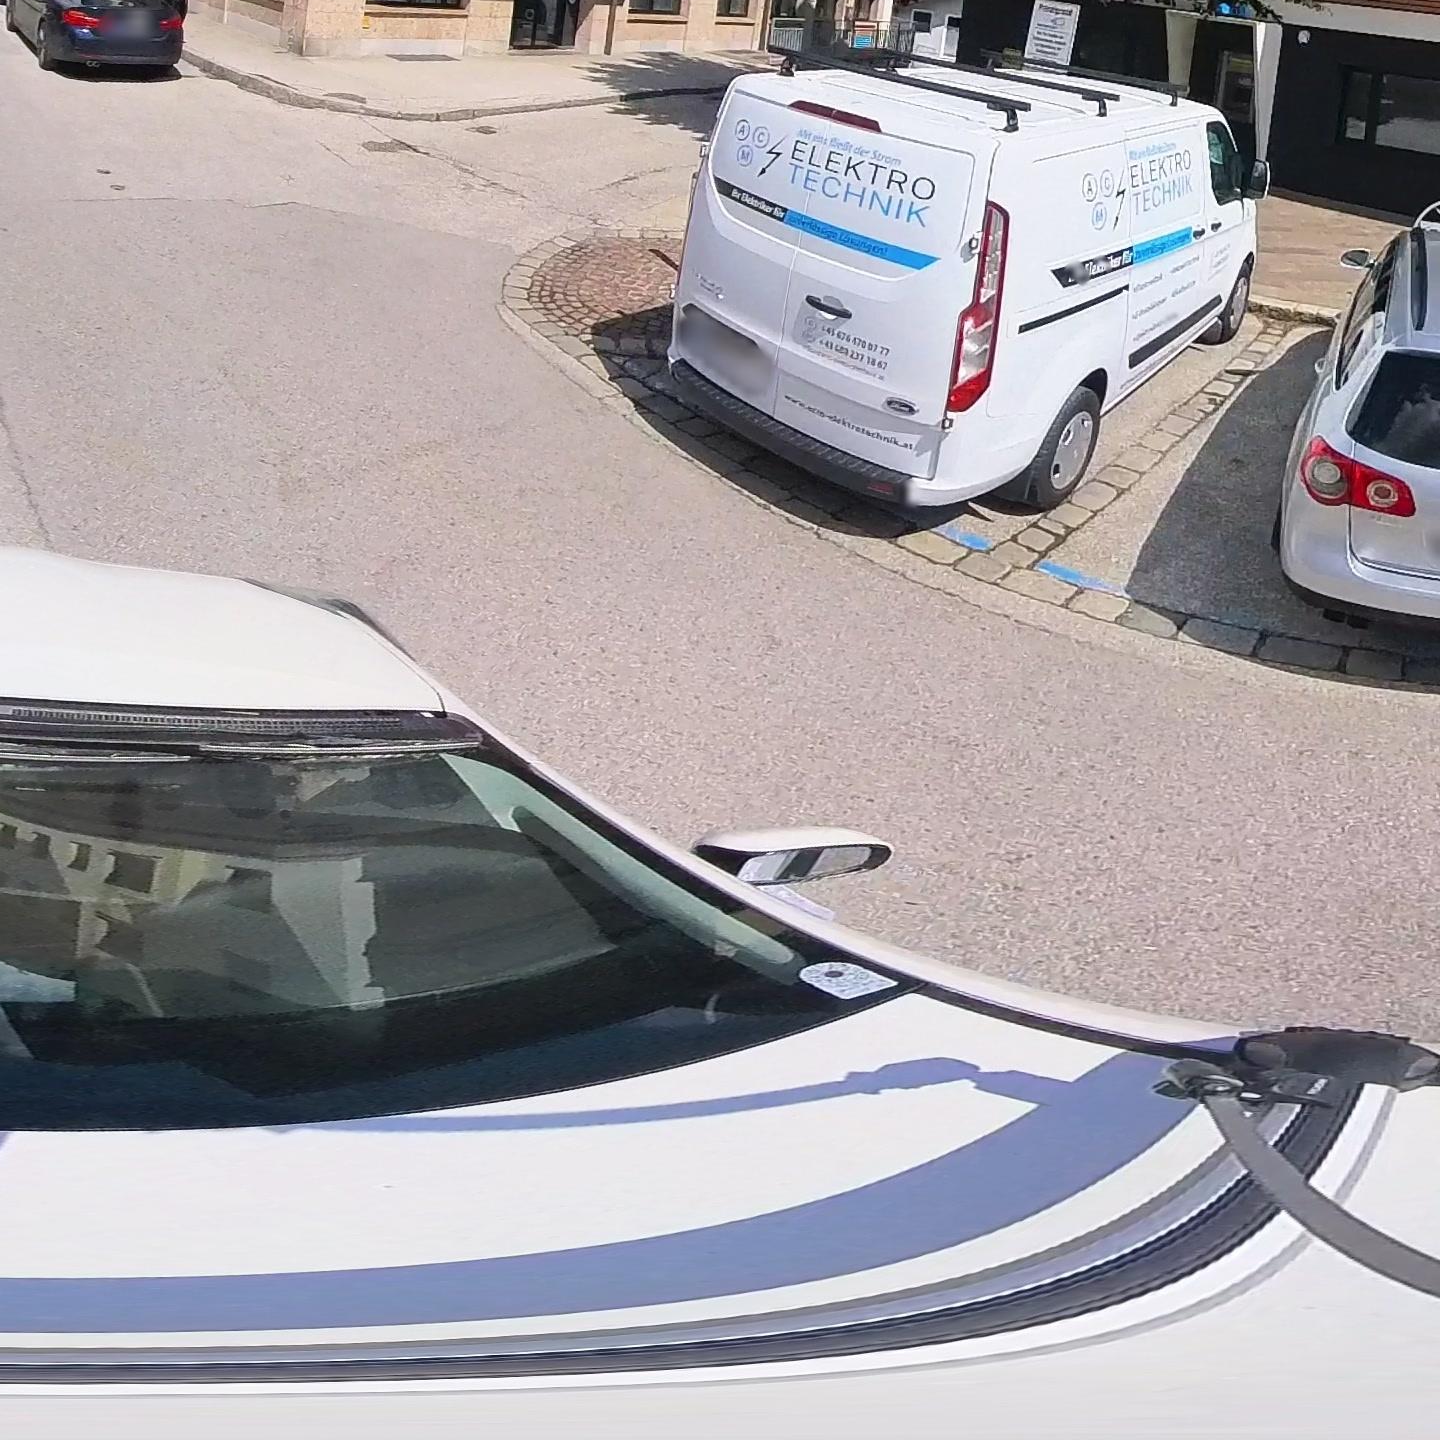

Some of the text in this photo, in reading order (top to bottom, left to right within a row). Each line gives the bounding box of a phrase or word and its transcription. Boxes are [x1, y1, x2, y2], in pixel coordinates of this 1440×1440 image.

[790, 139, 937, 201] ELEKTRO
[870, 149, 903, 166] Strom
[1130, 149, 1192, 189] ELEKTRO
[788, 162, 932, 228] TECHNIK
[1132, 173, 1193, 216] TECHNIK
[879, 346, 891, 357] 77
